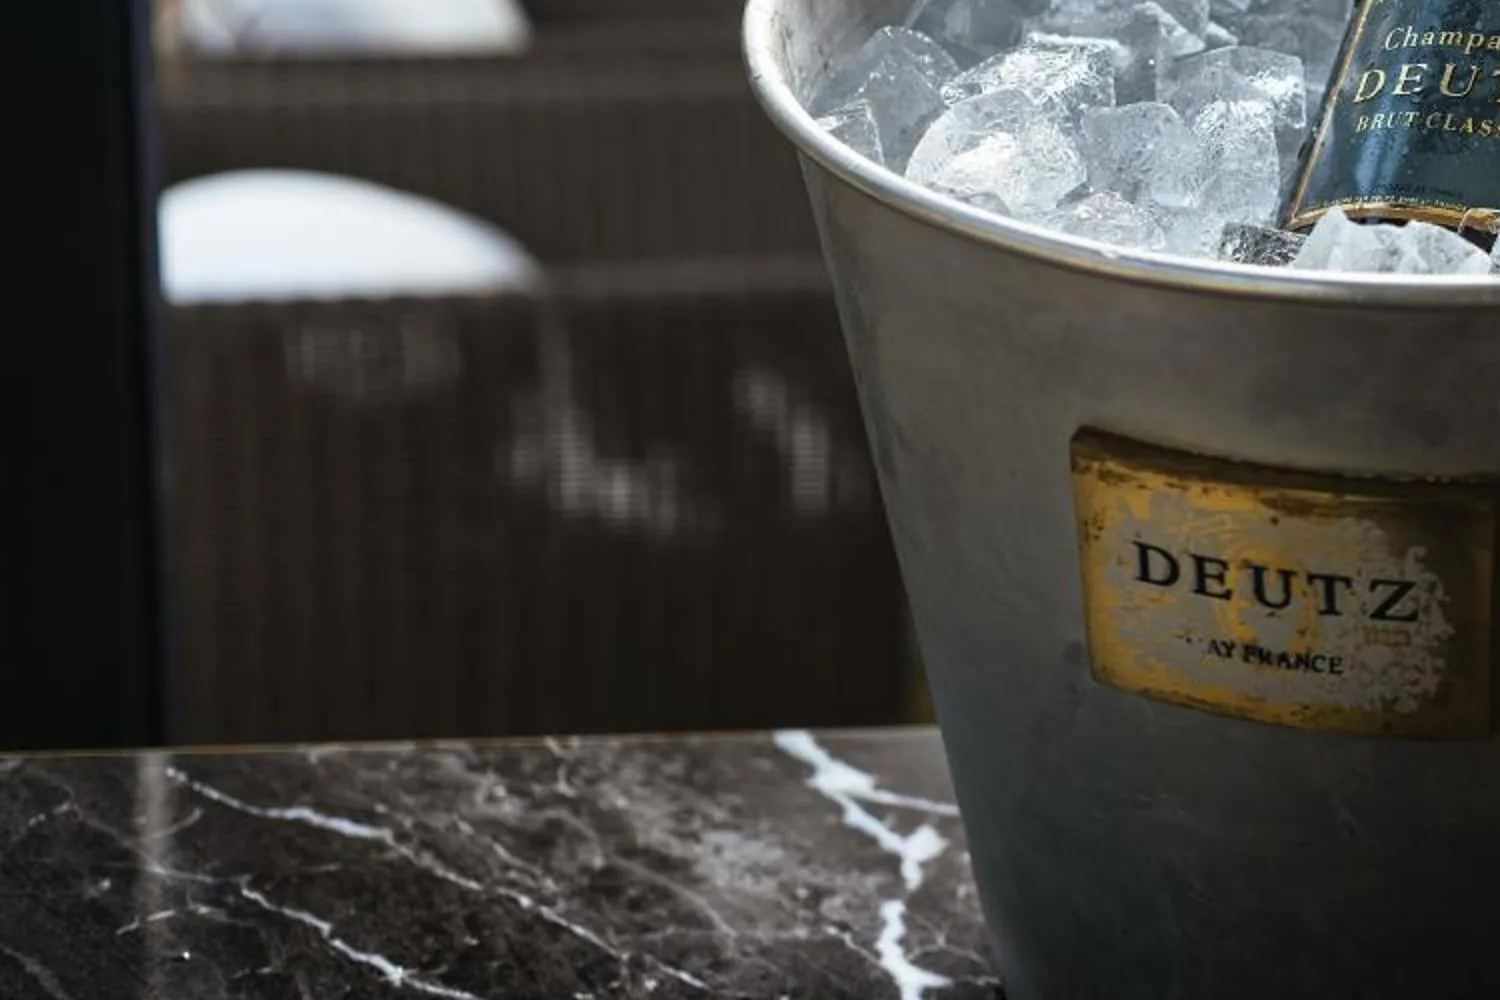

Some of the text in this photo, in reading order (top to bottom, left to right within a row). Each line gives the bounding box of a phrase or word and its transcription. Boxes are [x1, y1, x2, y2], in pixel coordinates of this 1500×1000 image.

[1355, 111, 1421, 133] BRUT
[1132, 541, 1420, 622] DEUTZ
[1207, 638, 1344, 675] AY FRANCE
